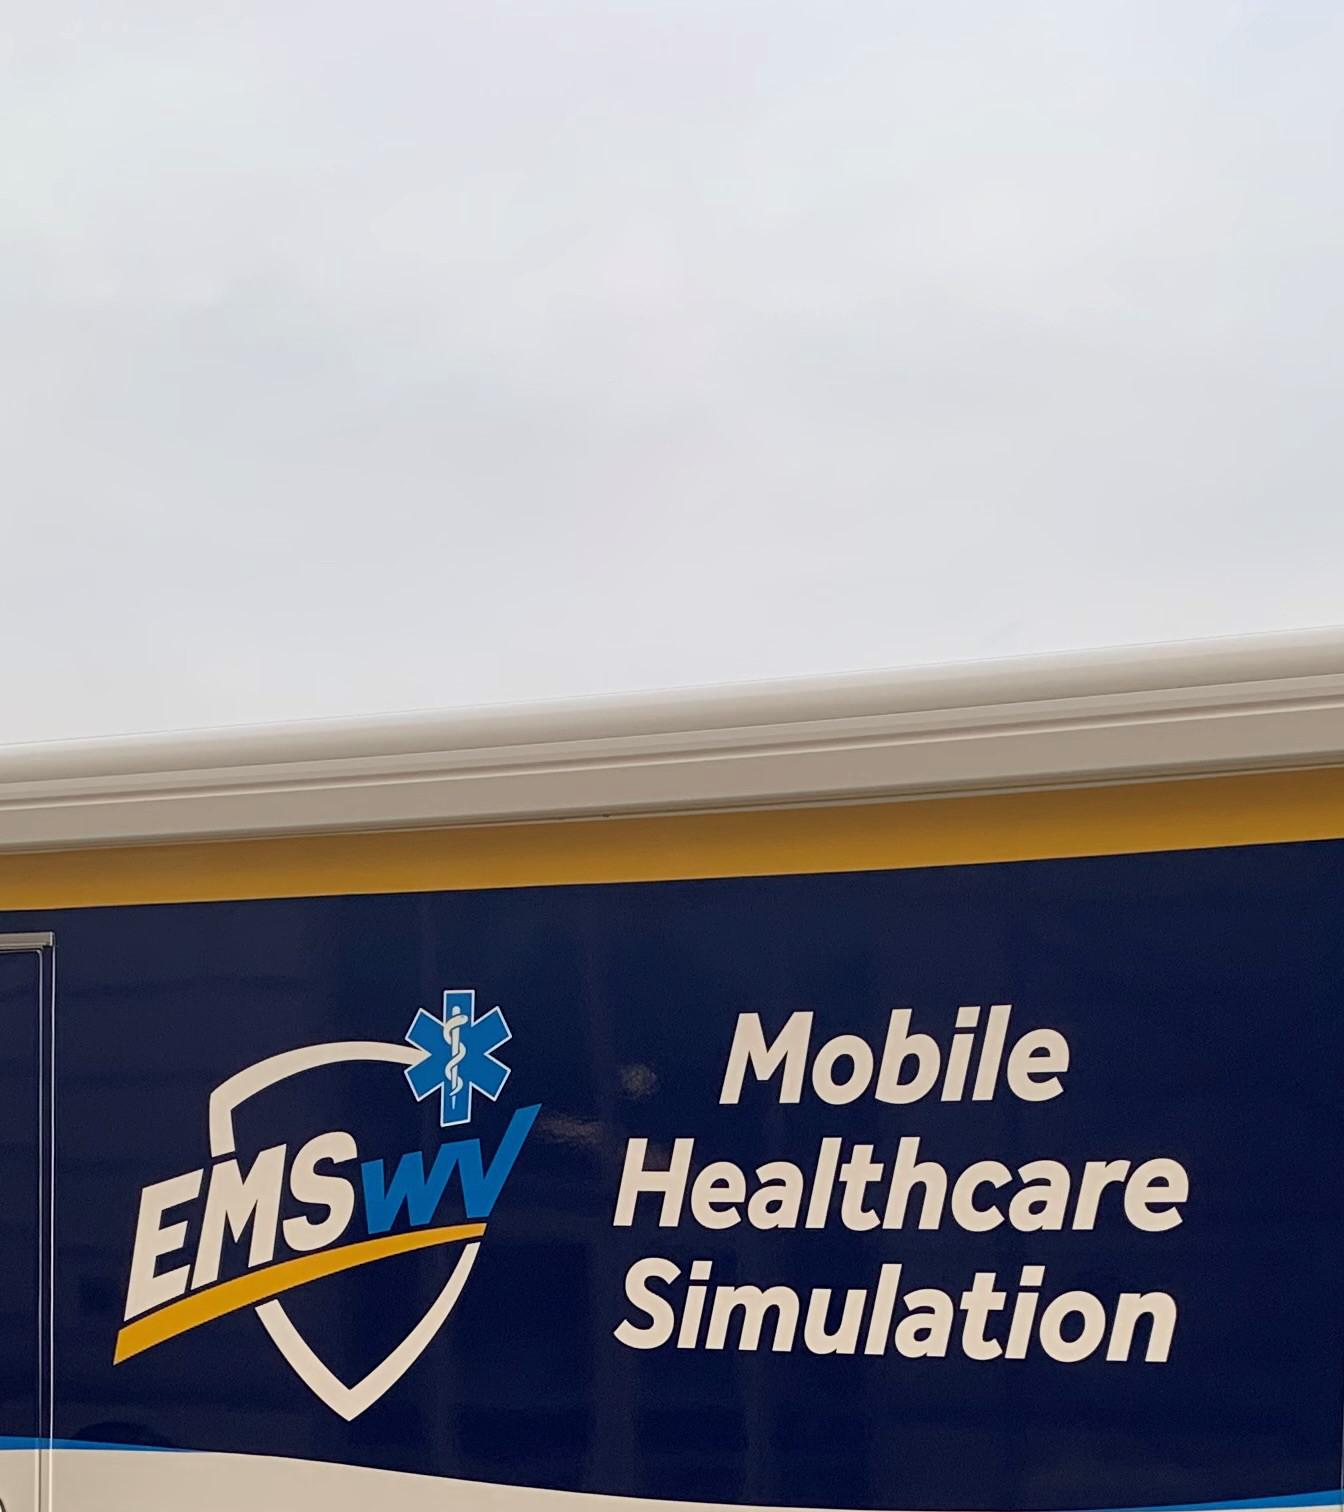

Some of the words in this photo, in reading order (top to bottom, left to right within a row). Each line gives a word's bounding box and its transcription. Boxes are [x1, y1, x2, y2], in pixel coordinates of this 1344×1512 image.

[719, 1004, 1070, 1105] Mobile
[613, 1136, 1189, 1233] Healthcare
[613, 1256, 1178, 1363] Simulation
